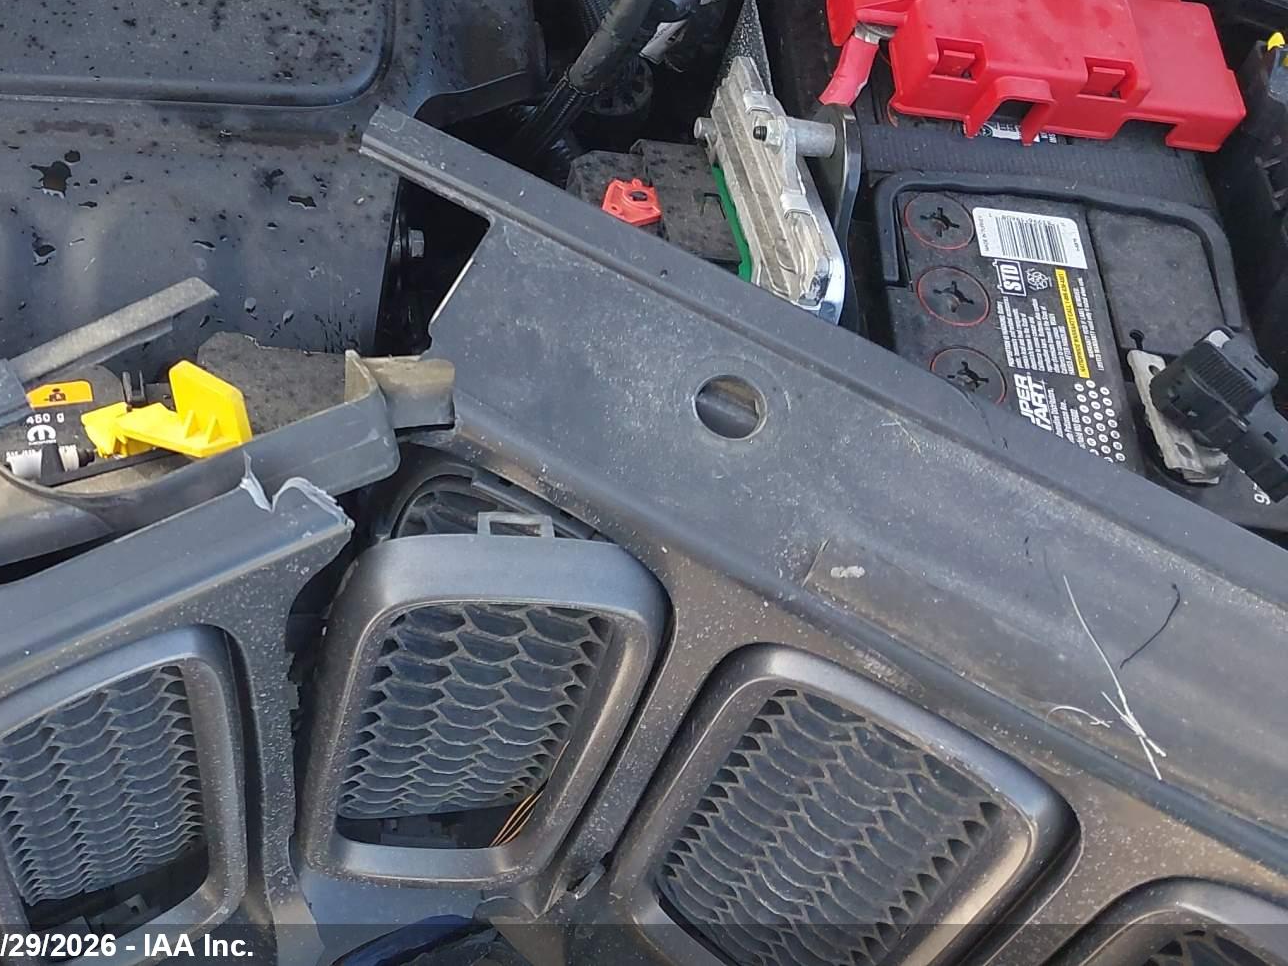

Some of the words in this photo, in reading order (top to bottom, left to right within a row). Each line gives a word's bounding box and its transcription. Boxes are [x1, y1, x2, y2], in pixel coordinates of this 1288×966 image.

[1000, 264, 1021, 290] STD
[1014, 374, 1035, 423] UPER
[1026, 376, 1051, 430] TART
[56, 413, 64, 423] g
